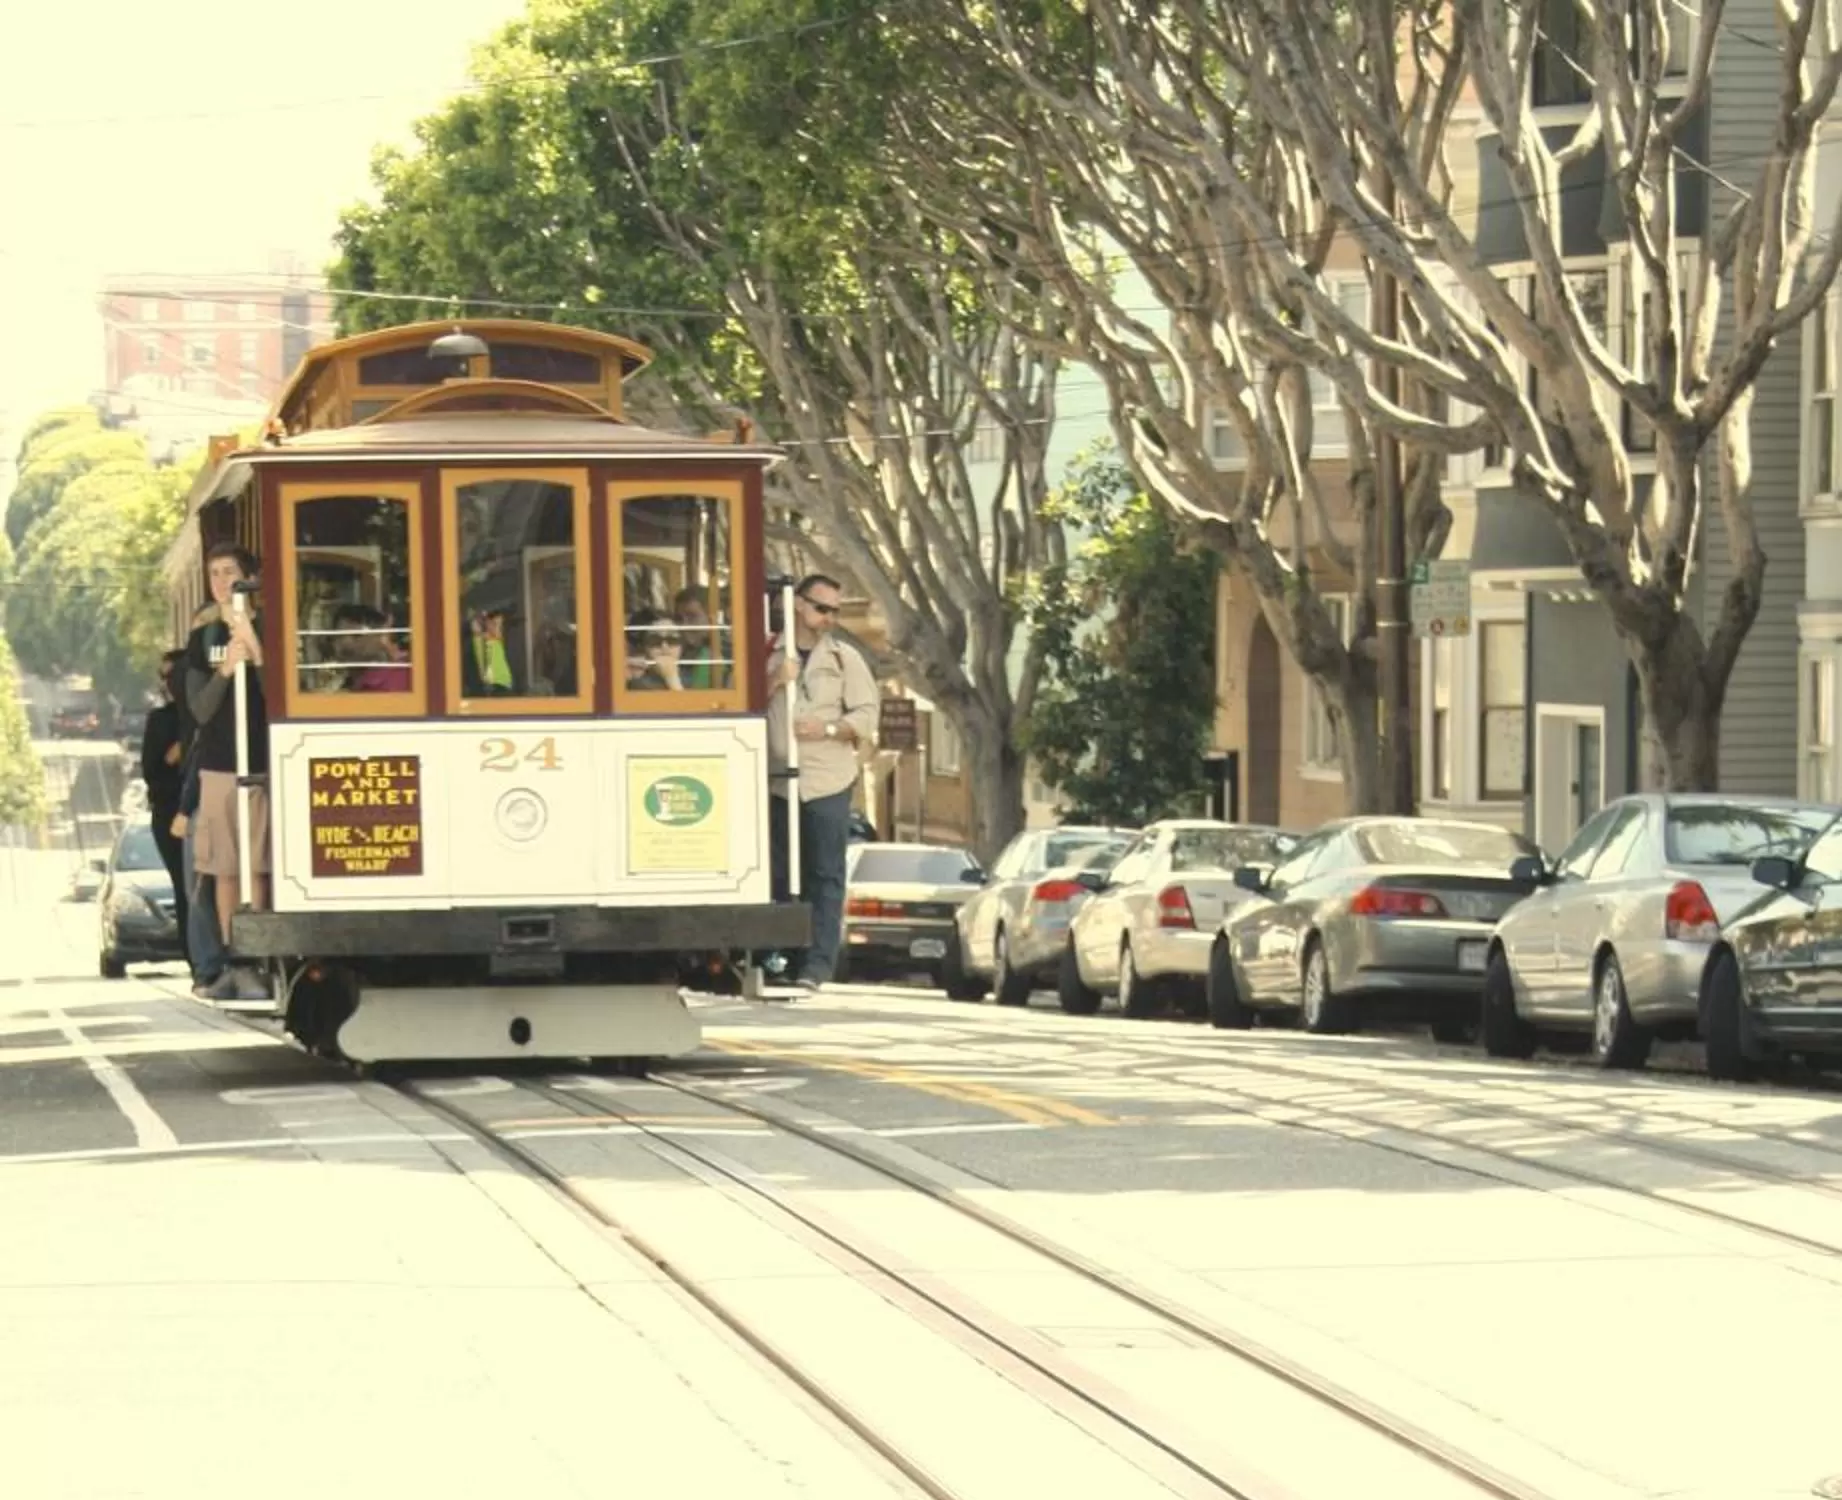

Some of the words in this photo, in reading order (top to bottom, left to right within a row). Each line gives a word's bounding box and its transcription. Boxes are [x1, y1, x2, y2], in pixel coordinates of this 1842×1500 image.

[480, 736, 564, 772] 24
[314, 762, 416, 778] POWELL
[341, 778, 391, 790] AND
[312, 789, 417, 807] MARKET
[316, 826, 352, 844] HYDE
[373, 825, 418, 842] BEACH
